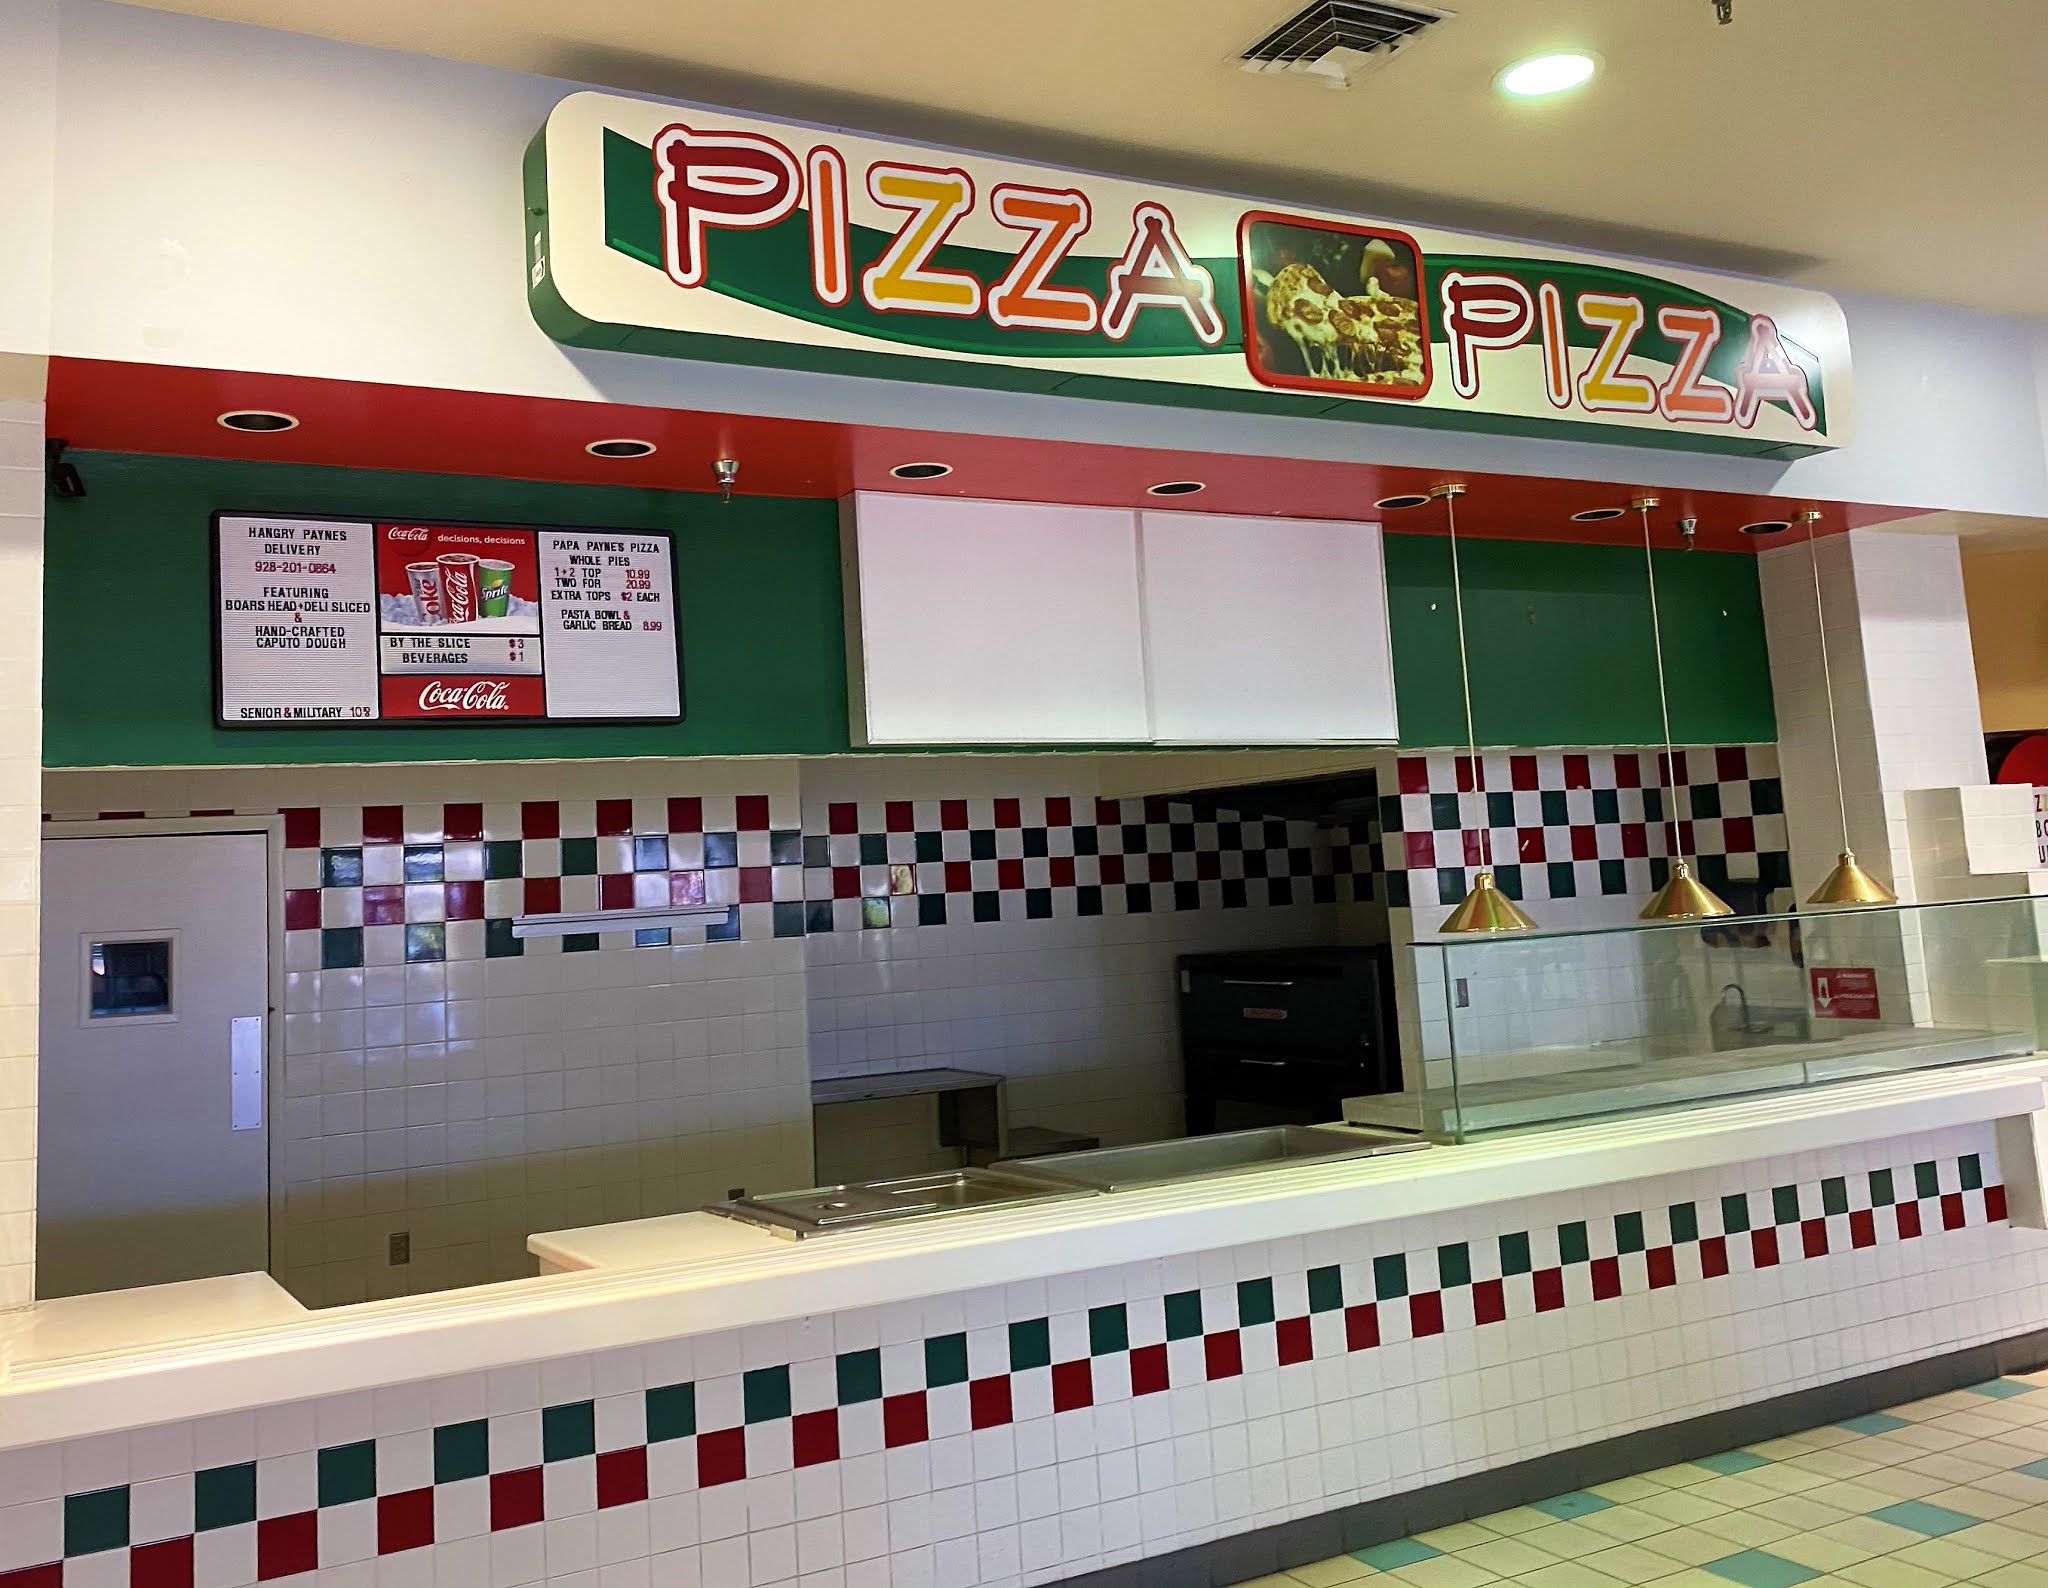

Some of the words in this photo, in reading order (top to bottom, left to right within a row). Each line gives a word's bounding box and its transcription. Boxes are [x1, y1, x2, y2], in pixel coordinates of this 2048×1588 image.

[653, 124, 1226, 347] PIZZA
[1441, 268, 1818, 431] PIZZA
[248, 527, 295, 539] HANGRY
[303, 529, 347, 541] PAYNES
[387, 526, 429, 541] Coca-Cola
[437, 534, 482, 544] decisions,
[484, 536, 525, 545] decisions
[264, 543, 321, 556] DELIVERY
[553, 540, 580, 551] PAPA
[630, 542, 660, 554] PIZZA
[569, 555, 602, 566] WHOLE
[608, 556, 631, 567] PIES
[582, 567, 602, 578] TOP
[555, 577, 577, 588] TWO
[583, 578, 602, 589] FOR
[263, 586, 329, 598] FEATURING
[551, 590, 582, 601] EXTRA
[586, 591, 611, 601] TOPS
[636, 592, 660, 602] EACH
[225, 600, 265, 611] BOARS
[331, 601, 370, 613] SLICED
[294, 612, 302, 623] &
[561, 609, 591, 620] PASTA
[595, 610, 621, 620] BOWL
[623, 610, 631, 620] &
[255, 625, 345, 637] HAND-CRAFTED
[563, 620, 597, 631] GARLIC
[602, 620, 632, 631] BREAD
[256, 638, 300, 648] CAPUTO
[306, 638, 346, 649] DOUGH
[390, 637, 405, 648] BY
[411, 637, 432, 648] THE
[438, 637, 471, 649] SLICE
[402, 652, 468, 664] BEVERAGES
[240, 707, 282, 719] SENIOR
[293, 707, 342, 718] MILITARY
